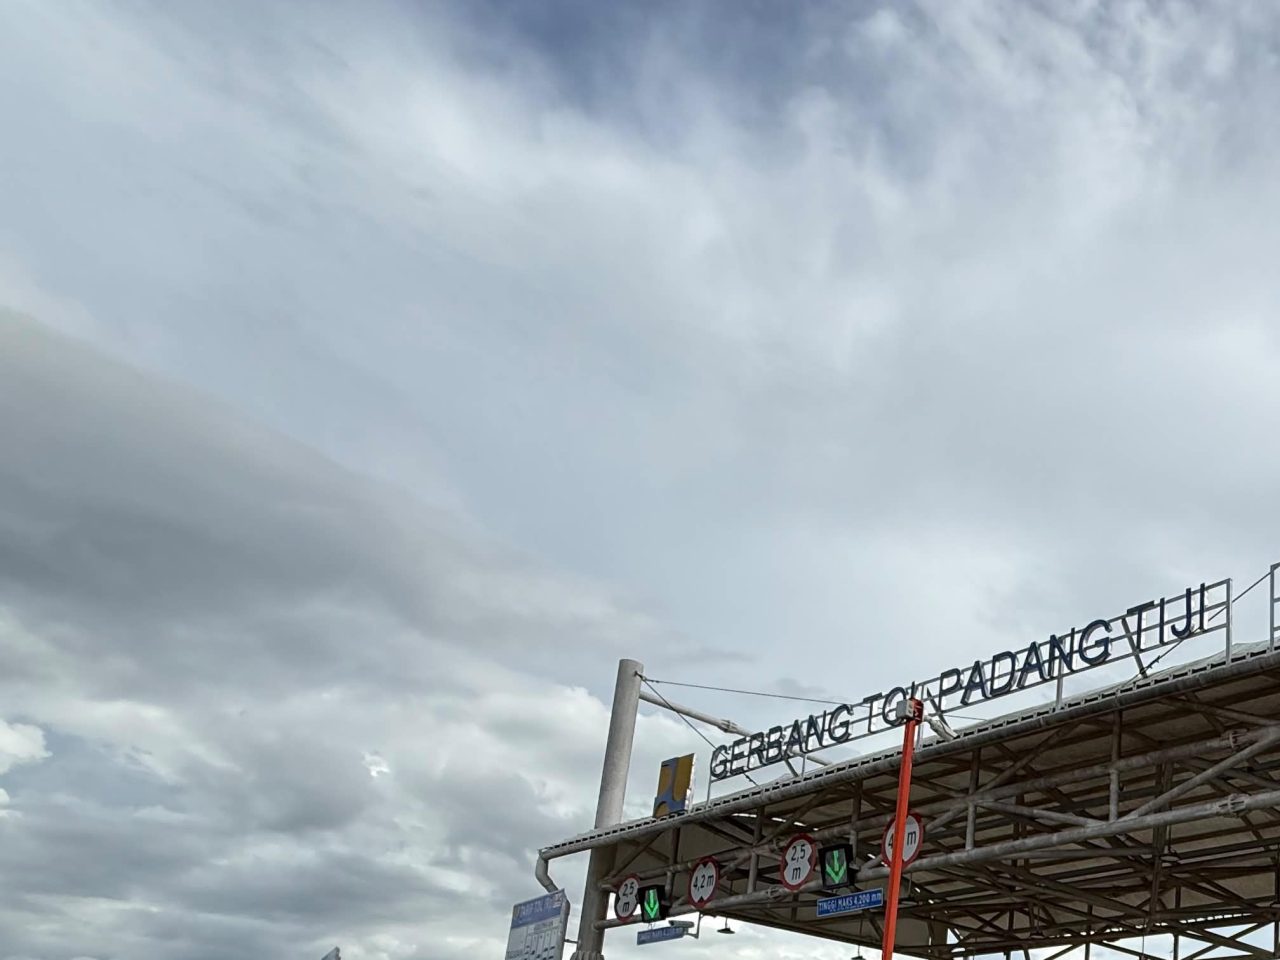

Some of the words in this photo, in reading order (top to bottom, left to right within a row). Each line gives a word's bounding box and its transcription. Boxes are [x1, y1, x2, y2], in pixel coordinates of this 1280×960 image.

[711, 704, 853, 779] GERBANG
[938, 620, 1112, 705] PADANG
[1126, 583, 1208, 651] TIJI
[791, 843, 806, 863] 2,5
[791, 866, 801, 881] m
